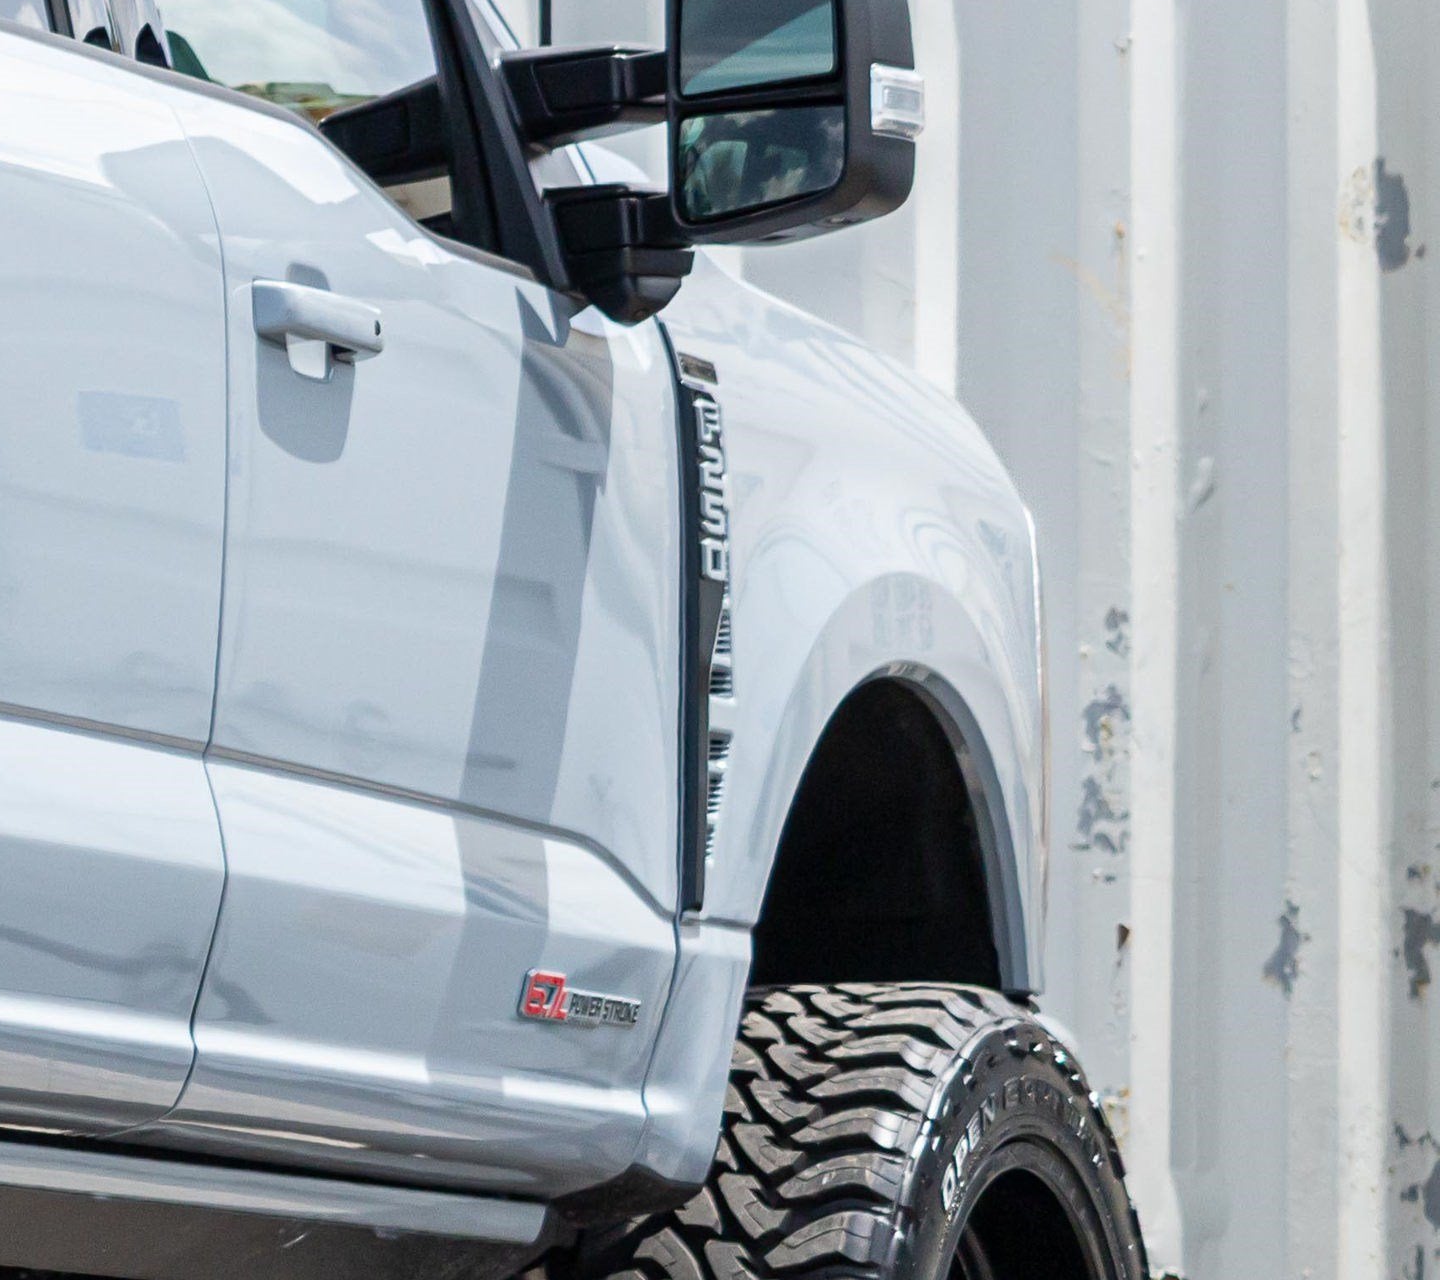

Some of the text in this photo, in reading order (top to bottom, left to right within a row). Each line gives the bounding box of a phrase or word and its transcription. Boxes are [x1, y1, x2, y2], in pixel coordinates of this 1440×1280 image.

[569, 992, 603, 1018] POWER
[601, 998, 640, 1024] STROKE
[941, 1093, 997, 1211] OPEN
